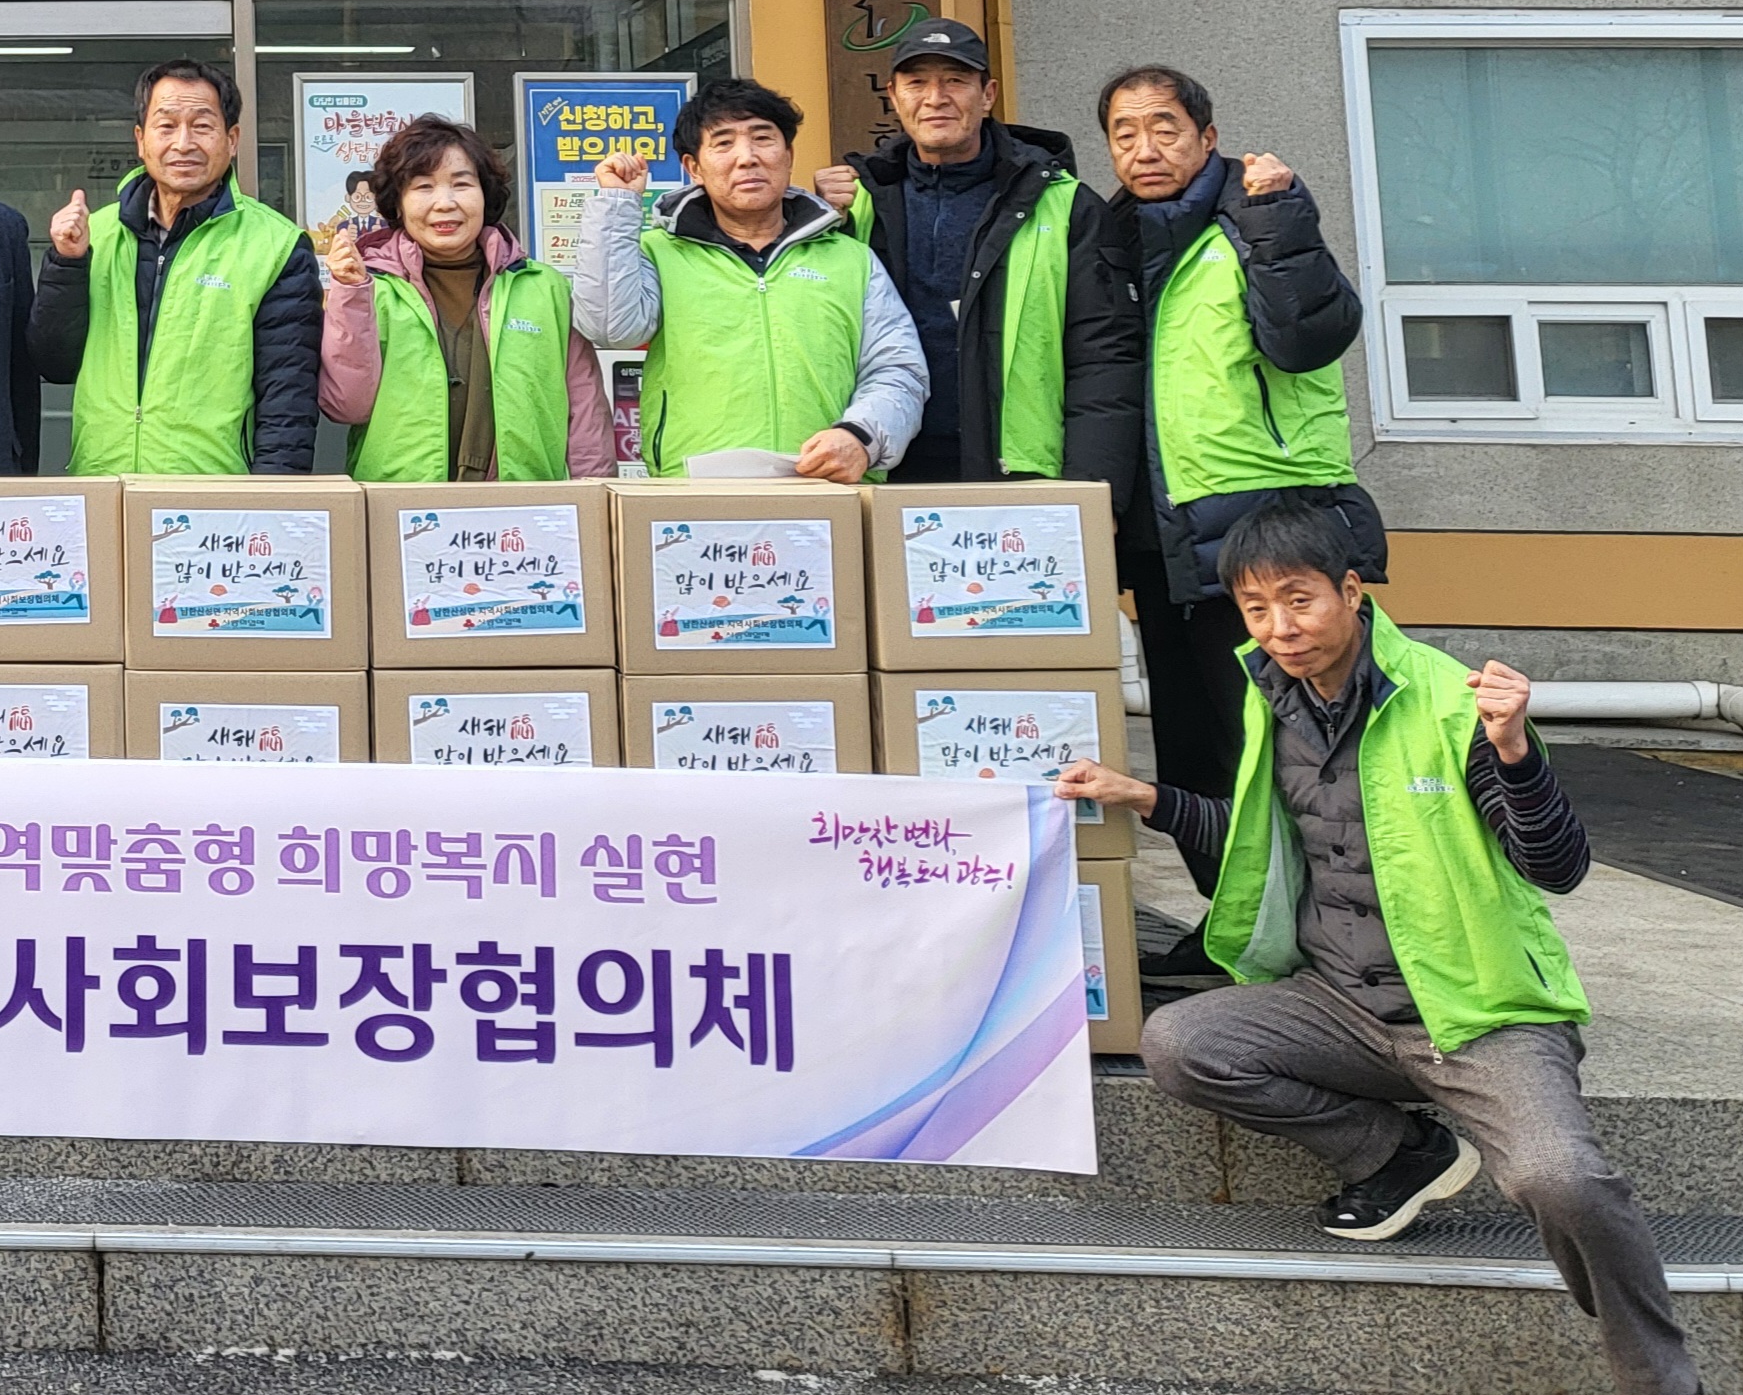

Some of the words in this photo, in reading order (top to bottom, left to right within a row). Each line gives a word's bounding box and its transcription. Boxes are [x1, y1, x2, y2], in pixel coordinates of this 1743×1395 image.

[558, 105, 665, 133] 신청하고,
[557, 136, 667, 161] 받으세요!
[175, 560, 212, 583] 많이
[221, 560, 308, 584] 받으세요
[425, 558, 465, 584] 많이
[473, 555, 564, 582] 받으세요
[929, 558, 968, 583] 많이
[975, 555, 1063, 581] 받으세요
[676, 570, 715, 595] 많이
[724, 569, 814, 595] 받으세요
[180, 607, 222, 616] 남한산성면
[433, 607, 477, 617] 남한산성면
[937, 606, 980, 616] 남한산성면
[682, 619, 725, 629] 남한산성면
[941, 743, 980, 767] 많이
[989, 743, 1078, 767] 받으세요
[808, 811, 899, 851] 희망찬
[278, 826, 557, 900] 희망복지
[581, 834, 718, 905] 실현
